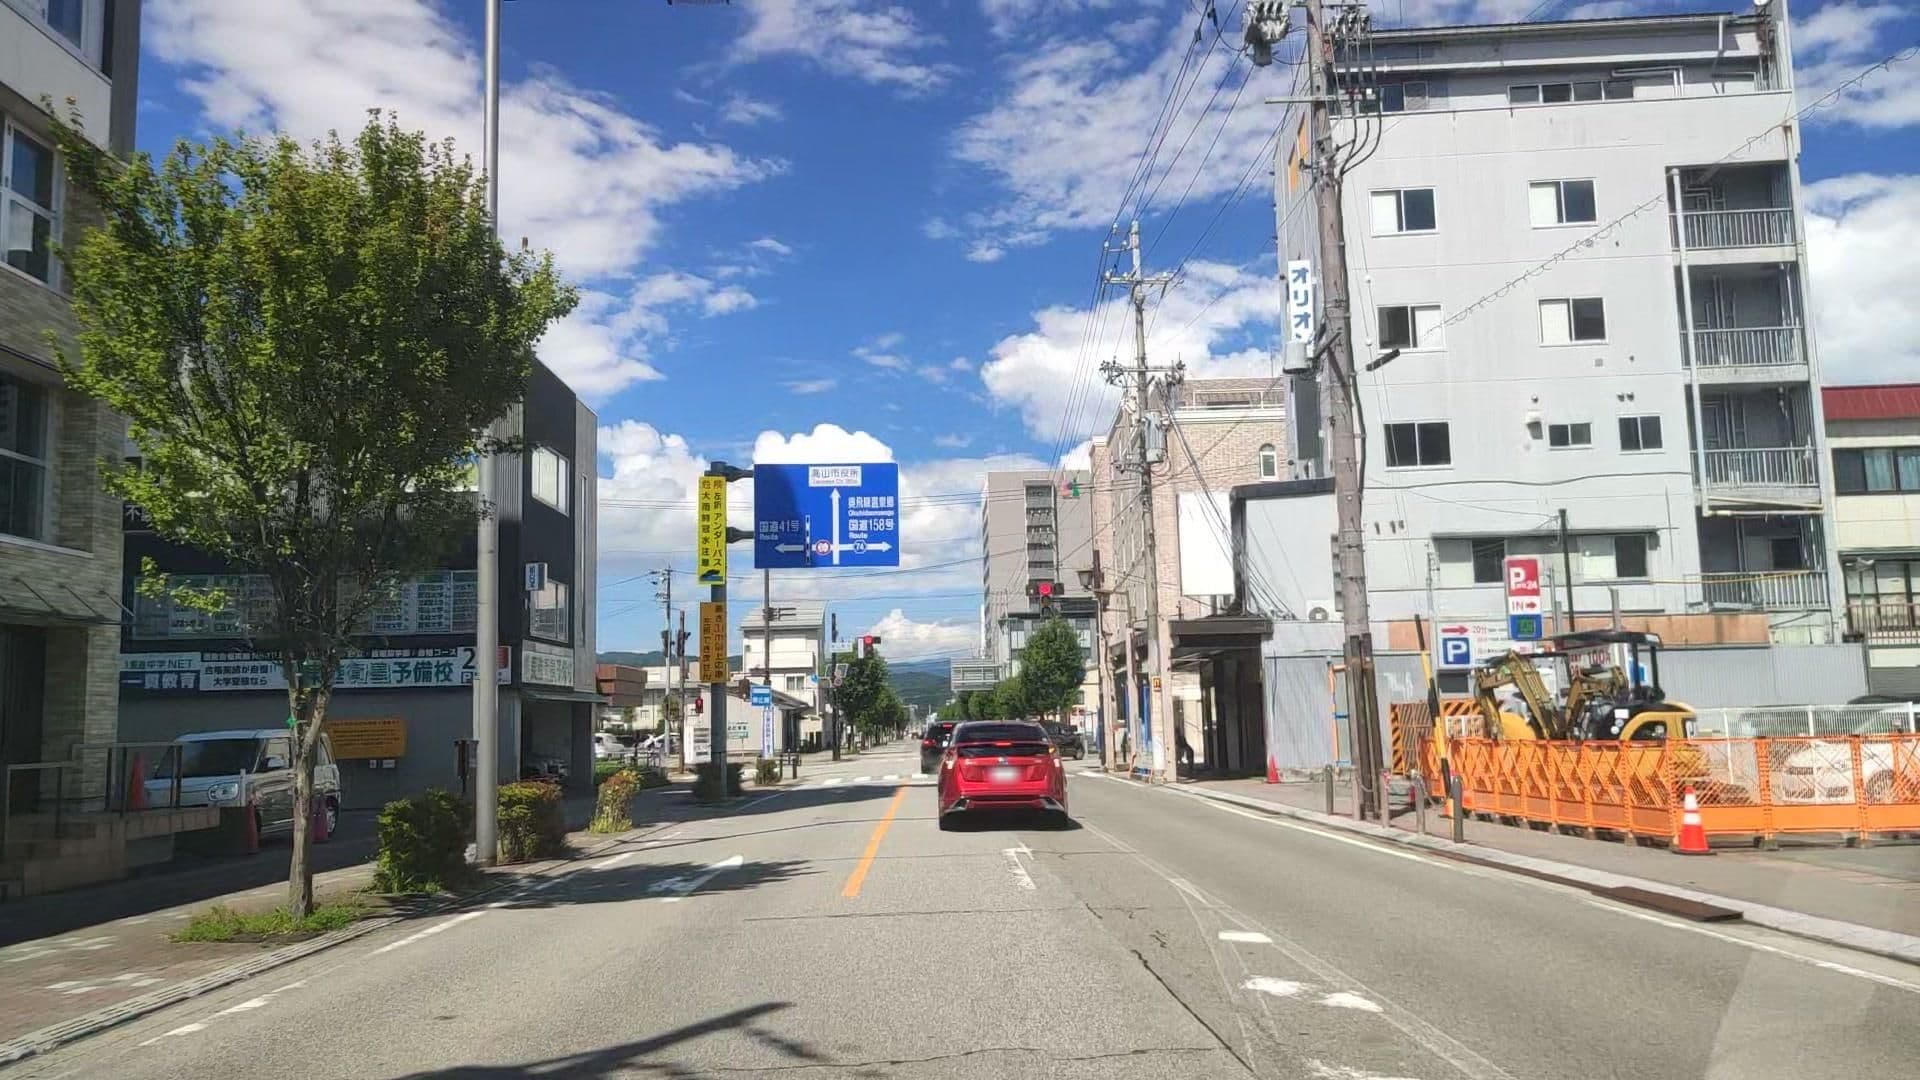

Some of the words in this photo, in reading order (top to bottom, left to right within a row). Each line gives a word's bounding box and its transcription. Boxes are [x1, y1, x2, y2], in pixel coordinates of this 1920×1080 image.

[759, 520, 799, 532] 国道41号
[848, 518, 894, 531] 国道158号
[855, 543, 864, 551] 74
[1512, 601, 1524, 611] IN
[1446, 639, 1467, 662] P
